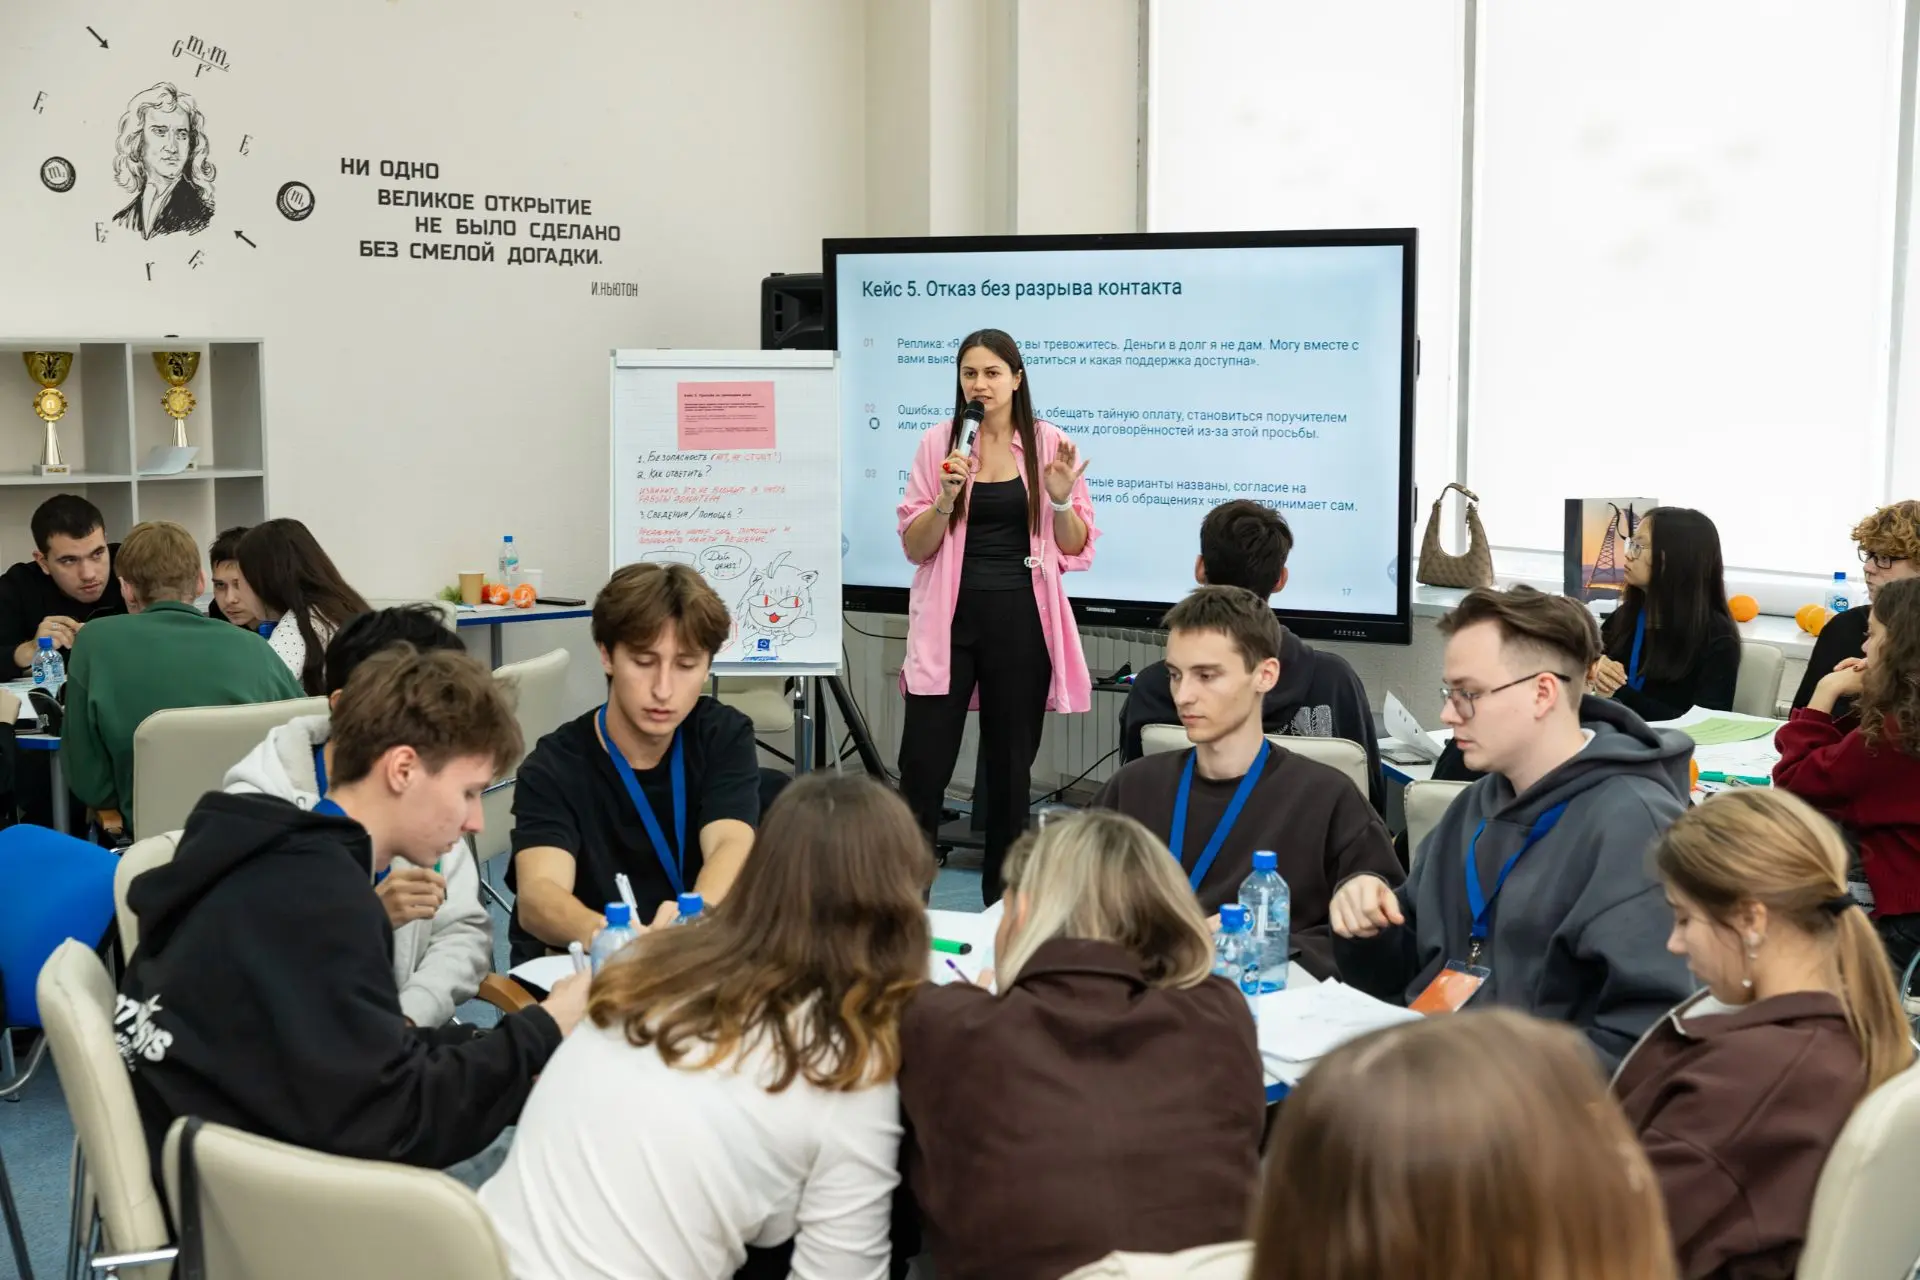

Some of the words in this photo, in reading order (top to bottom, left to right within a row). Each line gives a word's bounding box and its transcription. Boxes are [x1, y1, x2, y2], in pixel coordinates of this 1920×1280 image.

[341, 157, 370, 176] НИ
[380, 160, 439, 180] ОДНО
[378, 189, 474, 210] ВЕЛИКОЕ
[485, 195, 592, 215] ОТКРЫТИЕ
[415, 216, 442, 233] НЕ
[456, 218, 516, 236] БЫЛО
[530, 222, 621, 241] СДЕЛАНО
[360, 240, 399, 258] БЕЗ
[410, 241, 494, 262] СМЕЛОЙ
[507, 247, 603, 267] ДОГАДКИ.
[591, 281, 638, 297] И.НЬЮТОН
[862, 281, 902, 297] Кейс
[907, 281, 921, 297] 5.
[926, 280, 976, 297] Отказ
[981, 279, 1010, 297] без
[1016, 282, 1093, 300] разрыва
[1098, 281, 1182, 295] контакта
[863, 338, 874, 347] 01
[897, 338, 944, 350] Реплика:
[1025, 340, 1041, 350] вы
[1043, 340, 1119, 353] тревожитесь.
[1123, 339, 1166, 353] Деньги
[1169, 341, 1176, 350] в
[1179, 341, 1206, 353] долг
[1210, 341, 1217, 350] я
[1220, 341, 1235, 350] не
[1238, 341, 1266, 353] дам.
[1269, 339, 1300, 353] Могу
[1304, 341, 1349, 351] вместе
[1351, 341, 1360, 351] с
[897, 355, 925, 365] вами
[1080, 356, 1087, 365] и
[1090, 355, 1122, 366] какая
[1126, 355, 1191, 368] поддержка
[1194, 355, 1260, 369] доступна».
[898, 404, 942, 416] Ошибка:
[1046, 407, 1094, 420] обещать
[1097, 408, 1142, 421] тайную
[1142, 410, 1185, 422] оплату,
[1187, 411, 1263, 422] становиться
[1266, 412, 1347, 425] поручителем
[898, 421, 918, 430] или
[1092, 423, 1194, 436] договорённостей
[1197, 427, 1229, 437] из-за
[1231, 426, 1259, 438] этой
[1262, 427, 1319, 440] просьбы.
[1117, 480, 1173, 492] варианты
[1176, 481, 1231, 493] названы,
[1233, 482, 1289, 493] согласие
[1292, 484, 1307, 494] на
[1115, 491, 1129, 503] об
[1132, 493, 1205, 508] обращениях
[1330, 501, 1358, 512] сам.
[1342, 587, 1353, 597] 17
